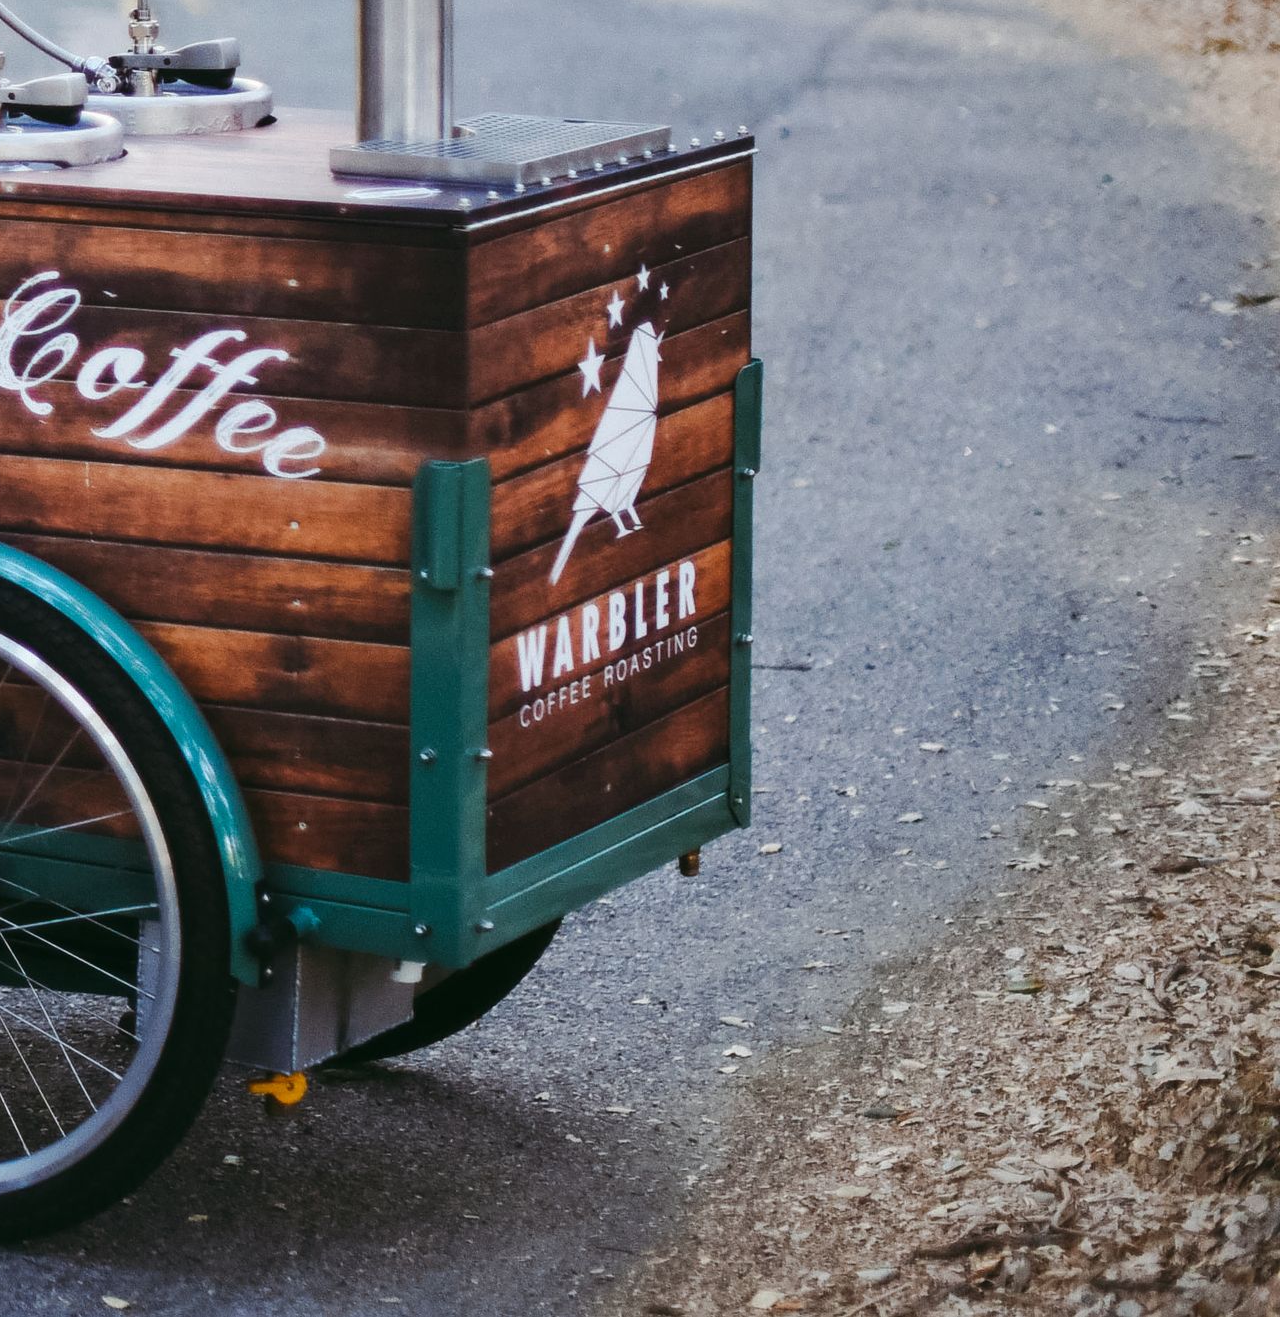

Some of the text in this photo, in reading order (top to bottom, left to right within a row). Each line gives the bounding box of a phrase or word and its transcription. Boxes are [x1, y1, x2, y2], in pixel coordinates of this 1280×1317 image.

[517, 560, 697, 693] WARBLER
[519, 625, 699, 729] COFFEE ROASTING
